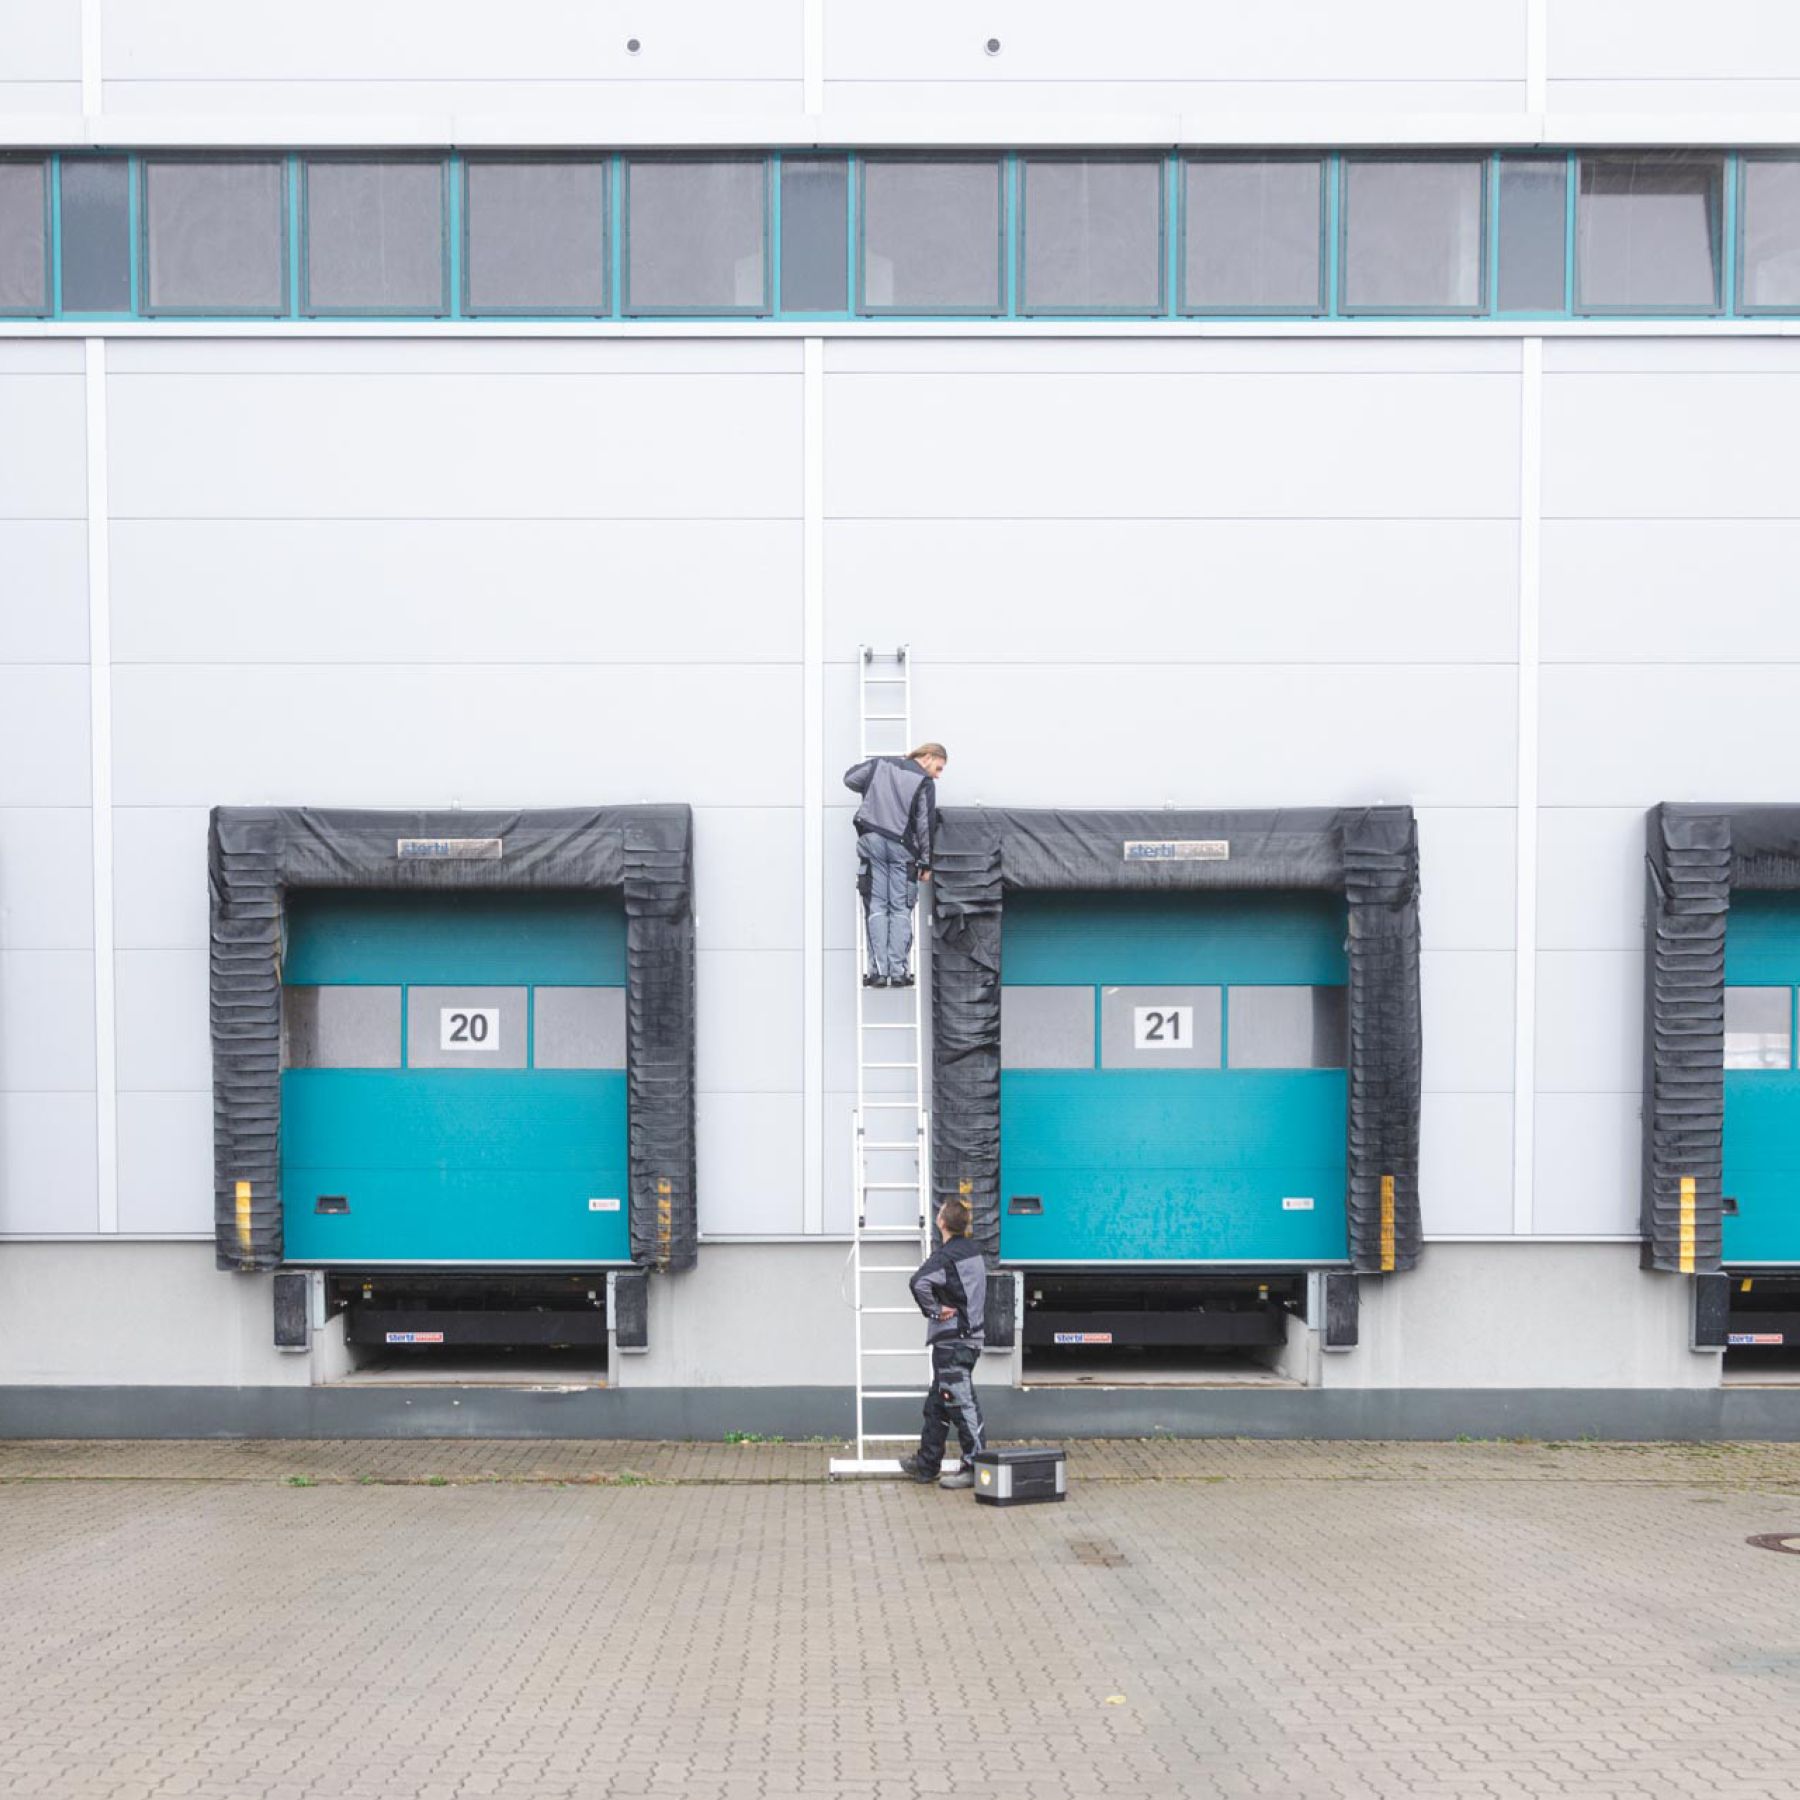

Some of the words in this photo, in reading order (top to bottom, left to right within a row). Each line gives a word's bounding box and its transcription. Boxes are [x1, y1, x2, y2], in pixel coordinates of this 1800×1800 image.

[1130, 844, 1175, 857] stertil
[450, 1014, 488, 1041] 20
[1146, 1012, 1179, 1040] 21
